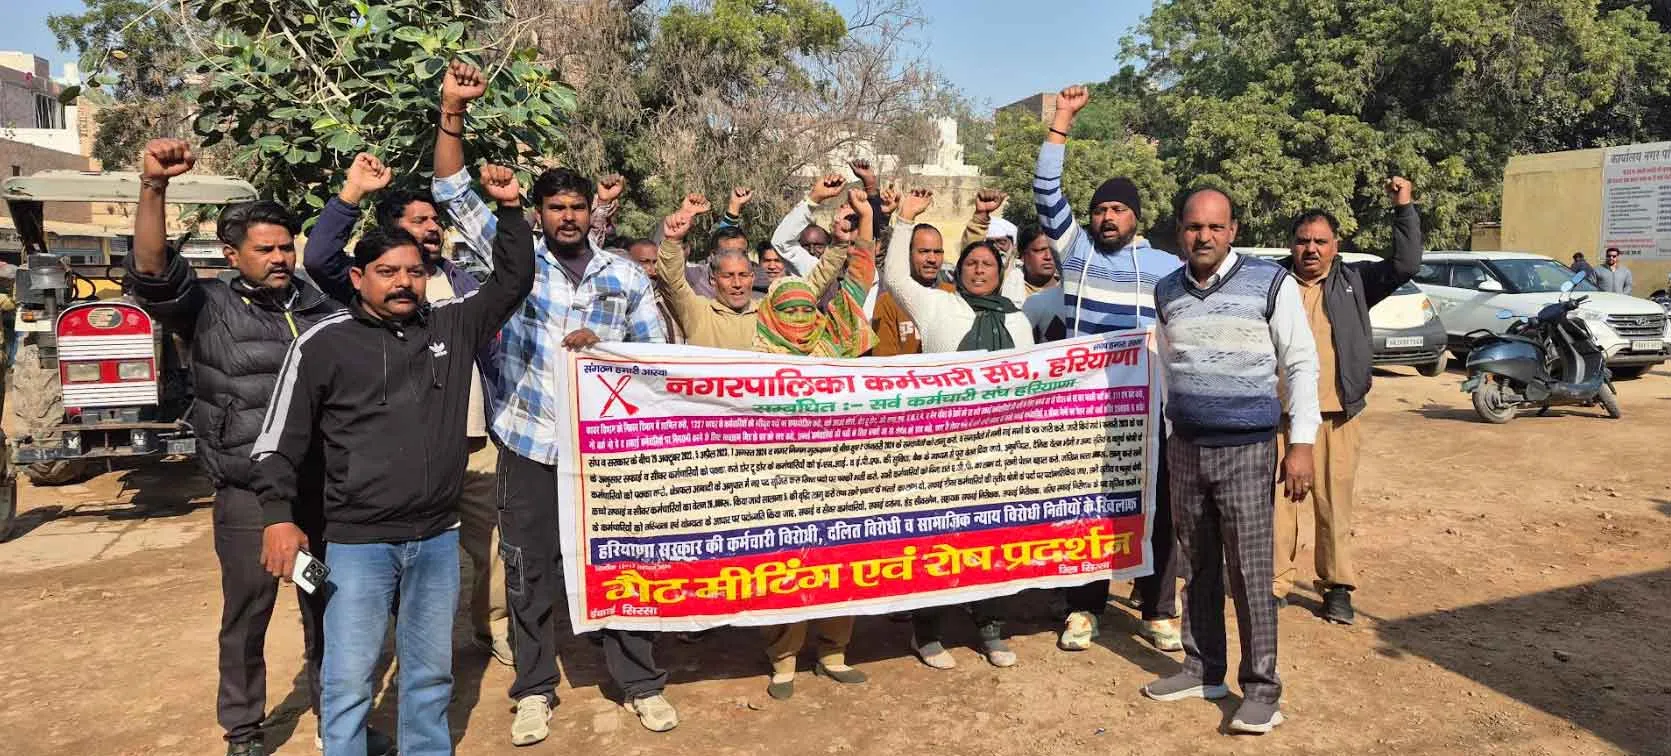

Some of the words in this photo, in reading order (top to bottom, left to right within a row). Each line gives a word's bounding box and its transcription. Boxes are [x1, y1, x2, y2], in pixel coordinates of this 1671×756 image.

[665, 368, 855, 398] नगरपालिका
[861, 367, 976, 392] कर्मचारी
[980, 361, 1039, 383] संघ,
[1046, 346, 1141, 379] हरियाणा
[869, 394, 902, 410] सर्व
[907, 388, 976, 408] कर्मचारी
[981, 386, 1009, 401] संघ
[1015, 378, 1074, 397] हरियाणा
[598, 542, 655, 559] हरियाणा
[658, 540, 703, 560] सरकार
[705, 535, 723, 554] की
[726, 530, 775, 552] कर्मचारी
[778, 525, 823, 546] विरोधी,
[827, 520, 861, 541] दलित
[864, 516, 901, 537] विरोधी
[905, 520, 916, 533] व
[917, 511, 971, 532] सामाजिक
[973, 508, 1001, 526] न्याय
[1003, 504, 1040, 523] विरोधी
[693, 557, 843, 600] मीटिंग
[850, 545, 917, 587] एवं
[921, 543, 993, 577] रोष
[1001, 526, 1135, 571] प्रदर्शन
